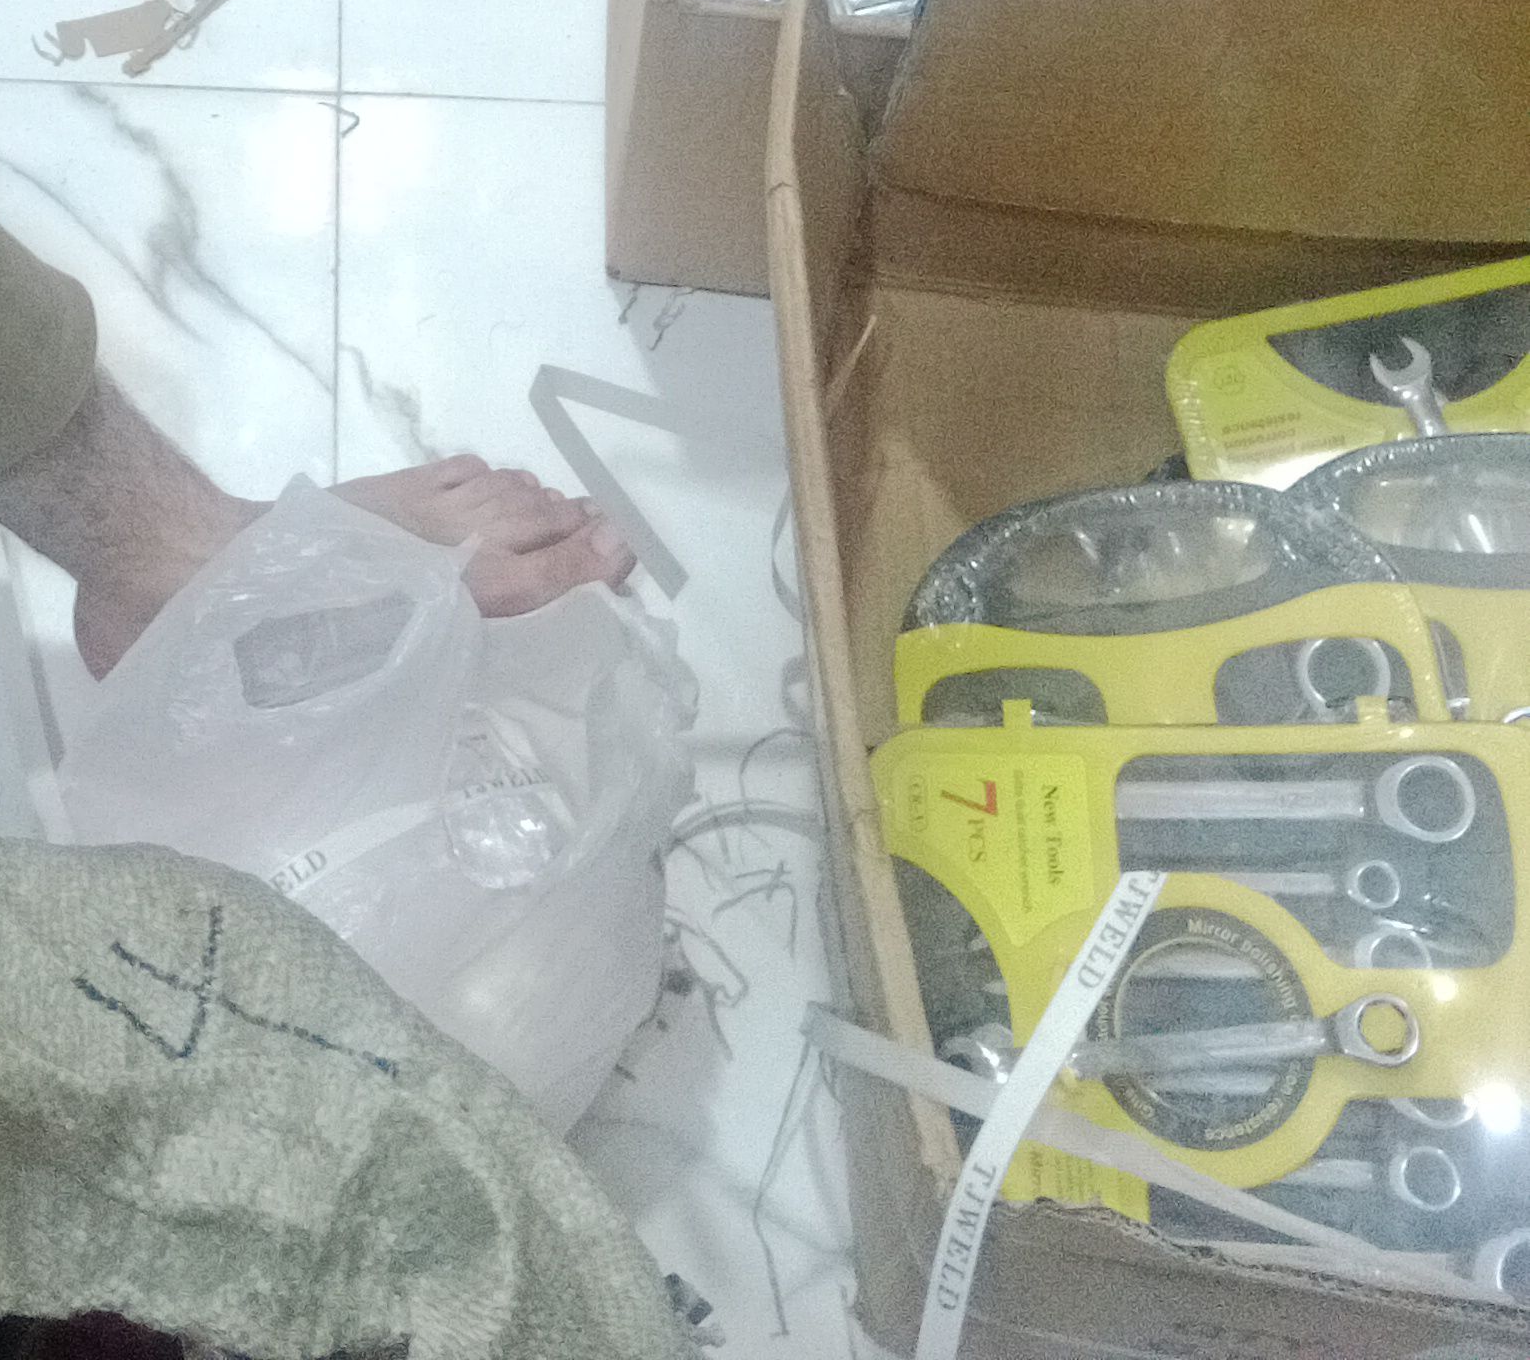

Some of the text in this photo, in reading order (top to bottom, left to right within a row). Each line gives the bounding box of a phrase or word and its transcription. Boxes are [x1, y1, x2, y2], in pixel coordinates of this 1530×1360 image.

[940, 779, 999, 817] 7
[1041, 784, 1066, 885] New Tools
[936, 1161, 997, 1313] TJWELD
